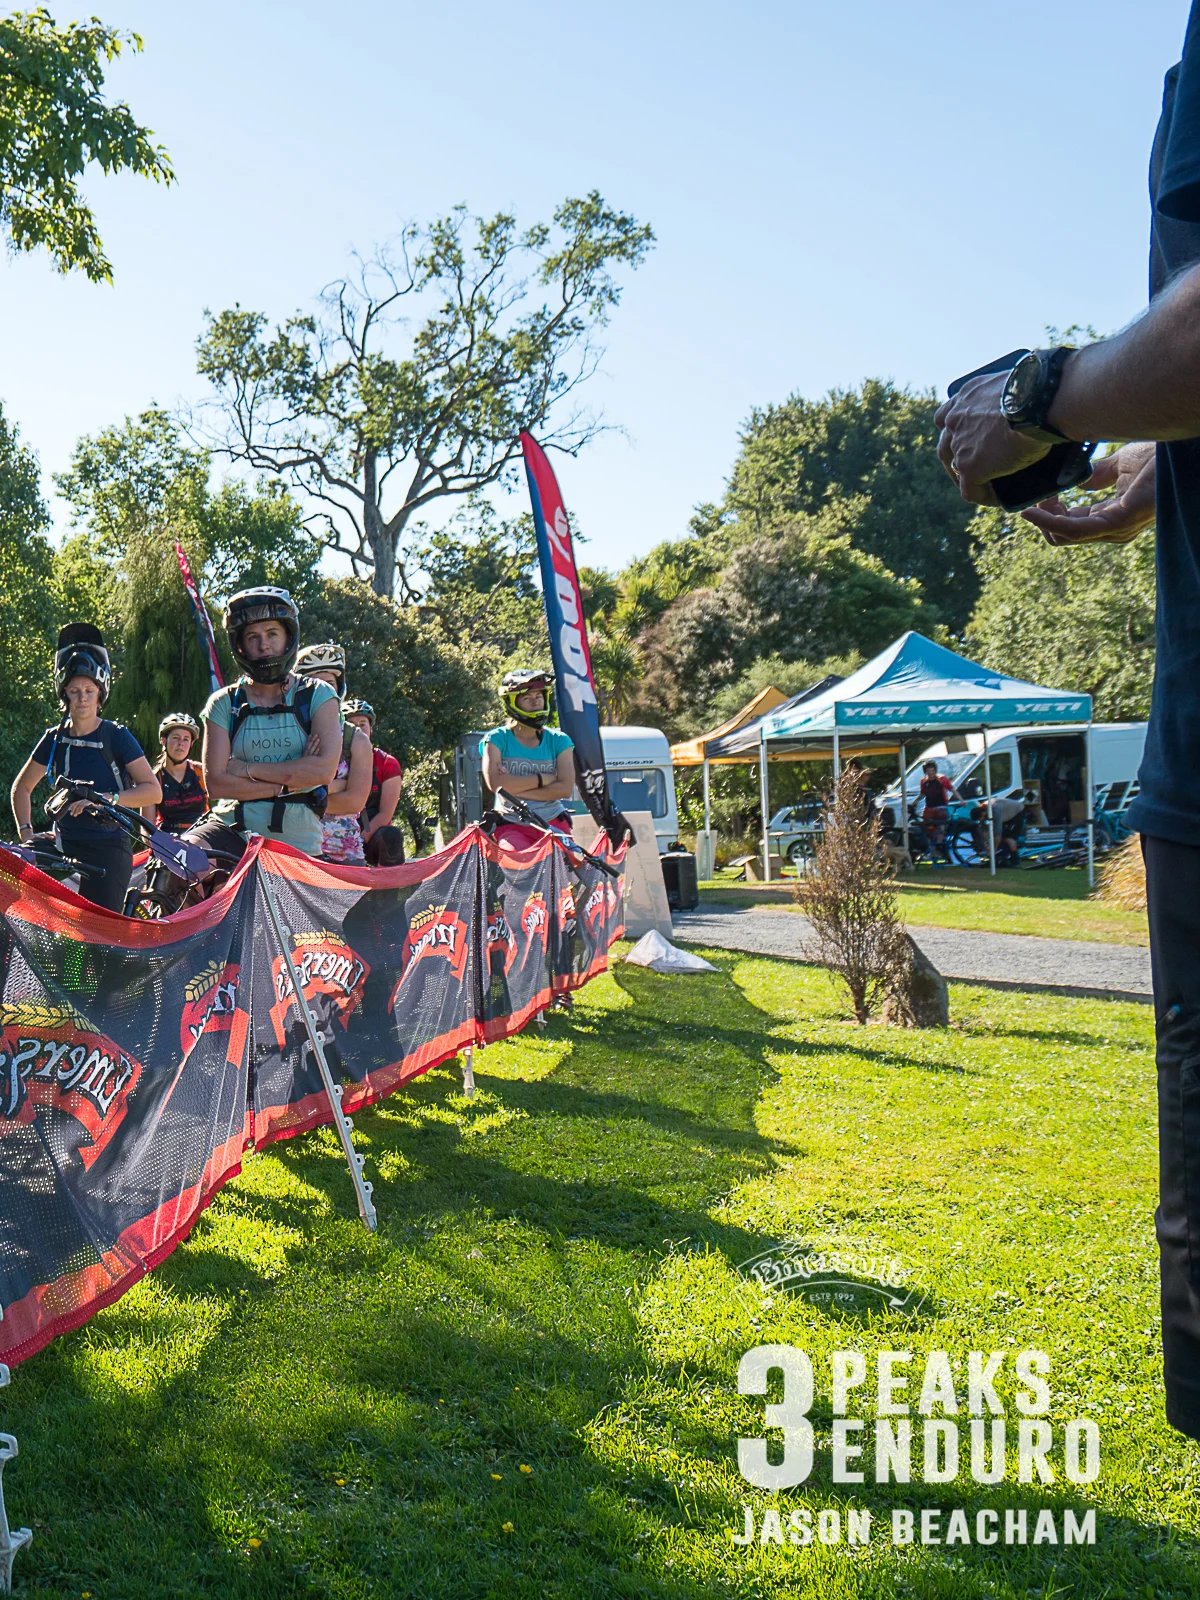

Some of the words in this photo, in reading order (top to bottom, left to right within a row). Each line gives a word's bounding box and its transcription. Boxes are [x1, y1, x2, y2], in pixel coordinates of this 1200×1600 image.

[546, 506, 597, 712] 100%
[844, 705, 910, 717] YETI
[927, 703, 994, 715] YETI
[1014, 701, 1083, 713] YETI
[251, 736, 292, 750] MONS
